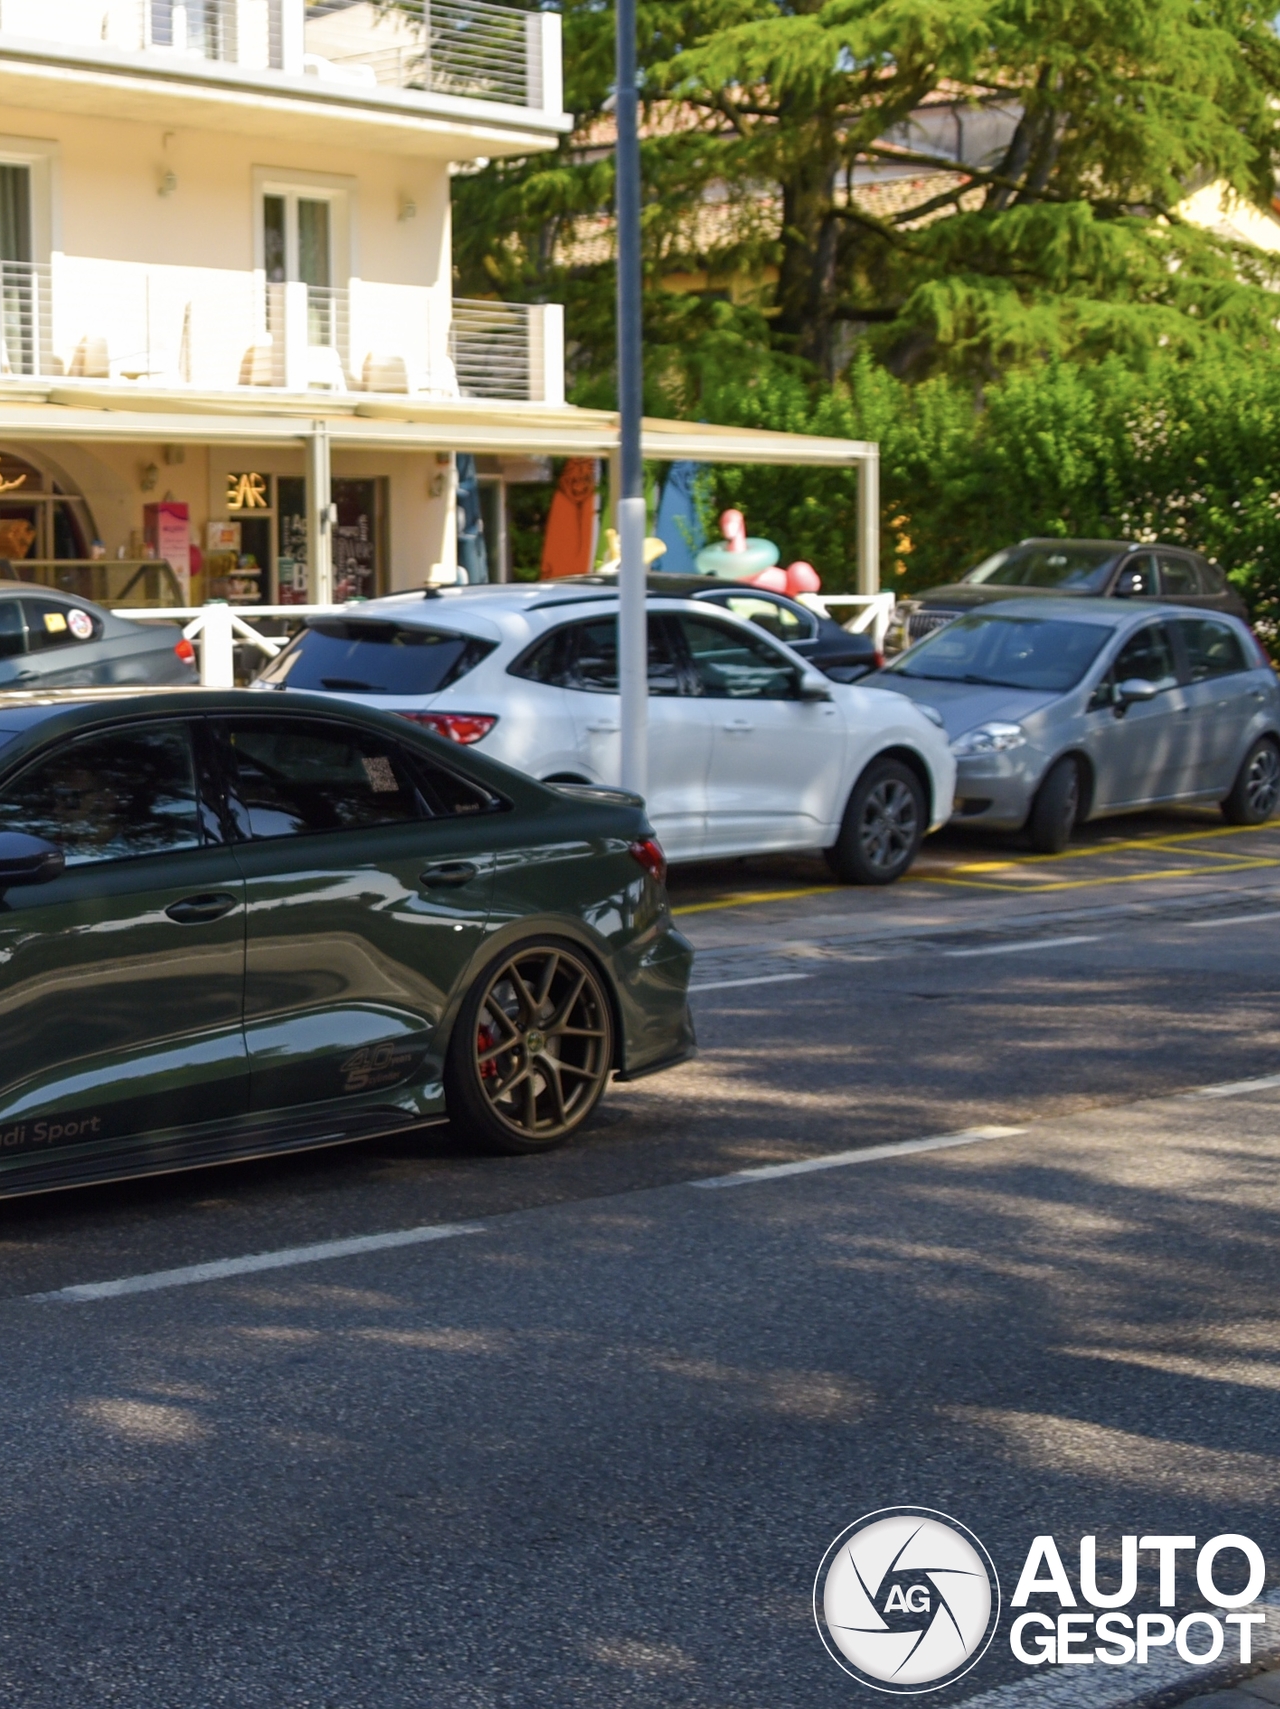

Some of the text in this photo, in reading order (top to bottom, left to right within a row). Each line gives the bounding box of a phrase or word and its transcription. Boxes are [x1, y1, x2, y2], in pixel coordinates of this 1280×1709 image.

[341, 1042, 395, 1073] 40
[344, 1067, 372, 1092] 5
[33, 1116, 102, 1143] Sport
